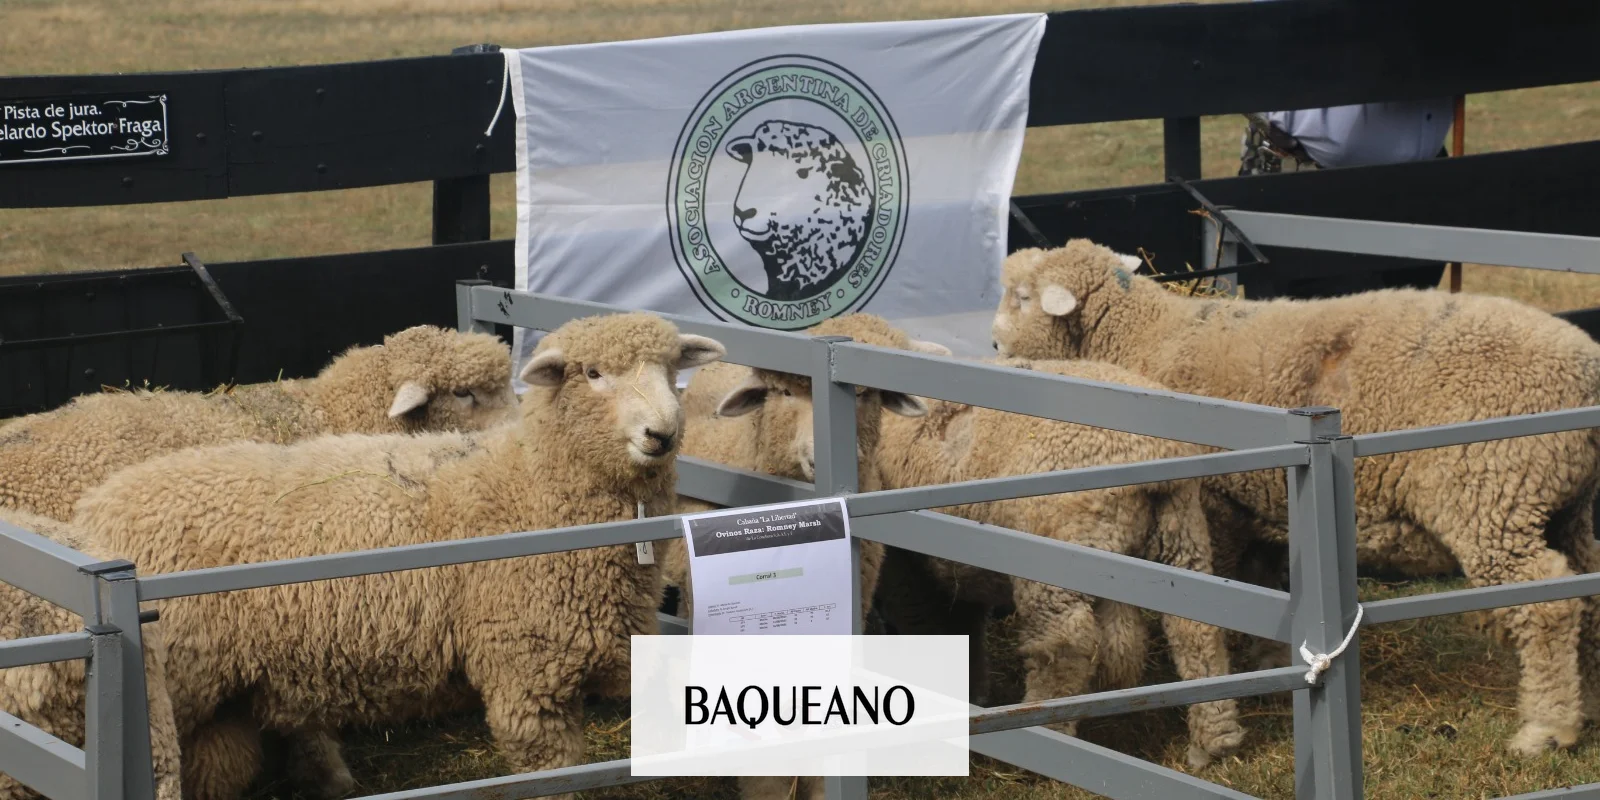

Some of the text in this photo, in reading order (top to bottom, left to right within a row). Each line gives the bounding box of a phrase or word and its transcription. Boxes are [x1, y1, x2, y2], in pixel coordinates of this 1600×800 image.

[4, 103, 102, 120] Pista de jura.
[51, 120, 114, 141] Spektor
[118, 117, 162, 138] Fraga
[684, 74, 893, 288] ASOCIACION ARGENTINA DE CRIADORES
[743, 294, 831, 321] ROMNEY
[715, 530, 743, 539] Ovinos
[744, 527, 765, 536] Raza:
[766, 523, 797, 533] Romney
[798, 519, 822, 528] Marsh
